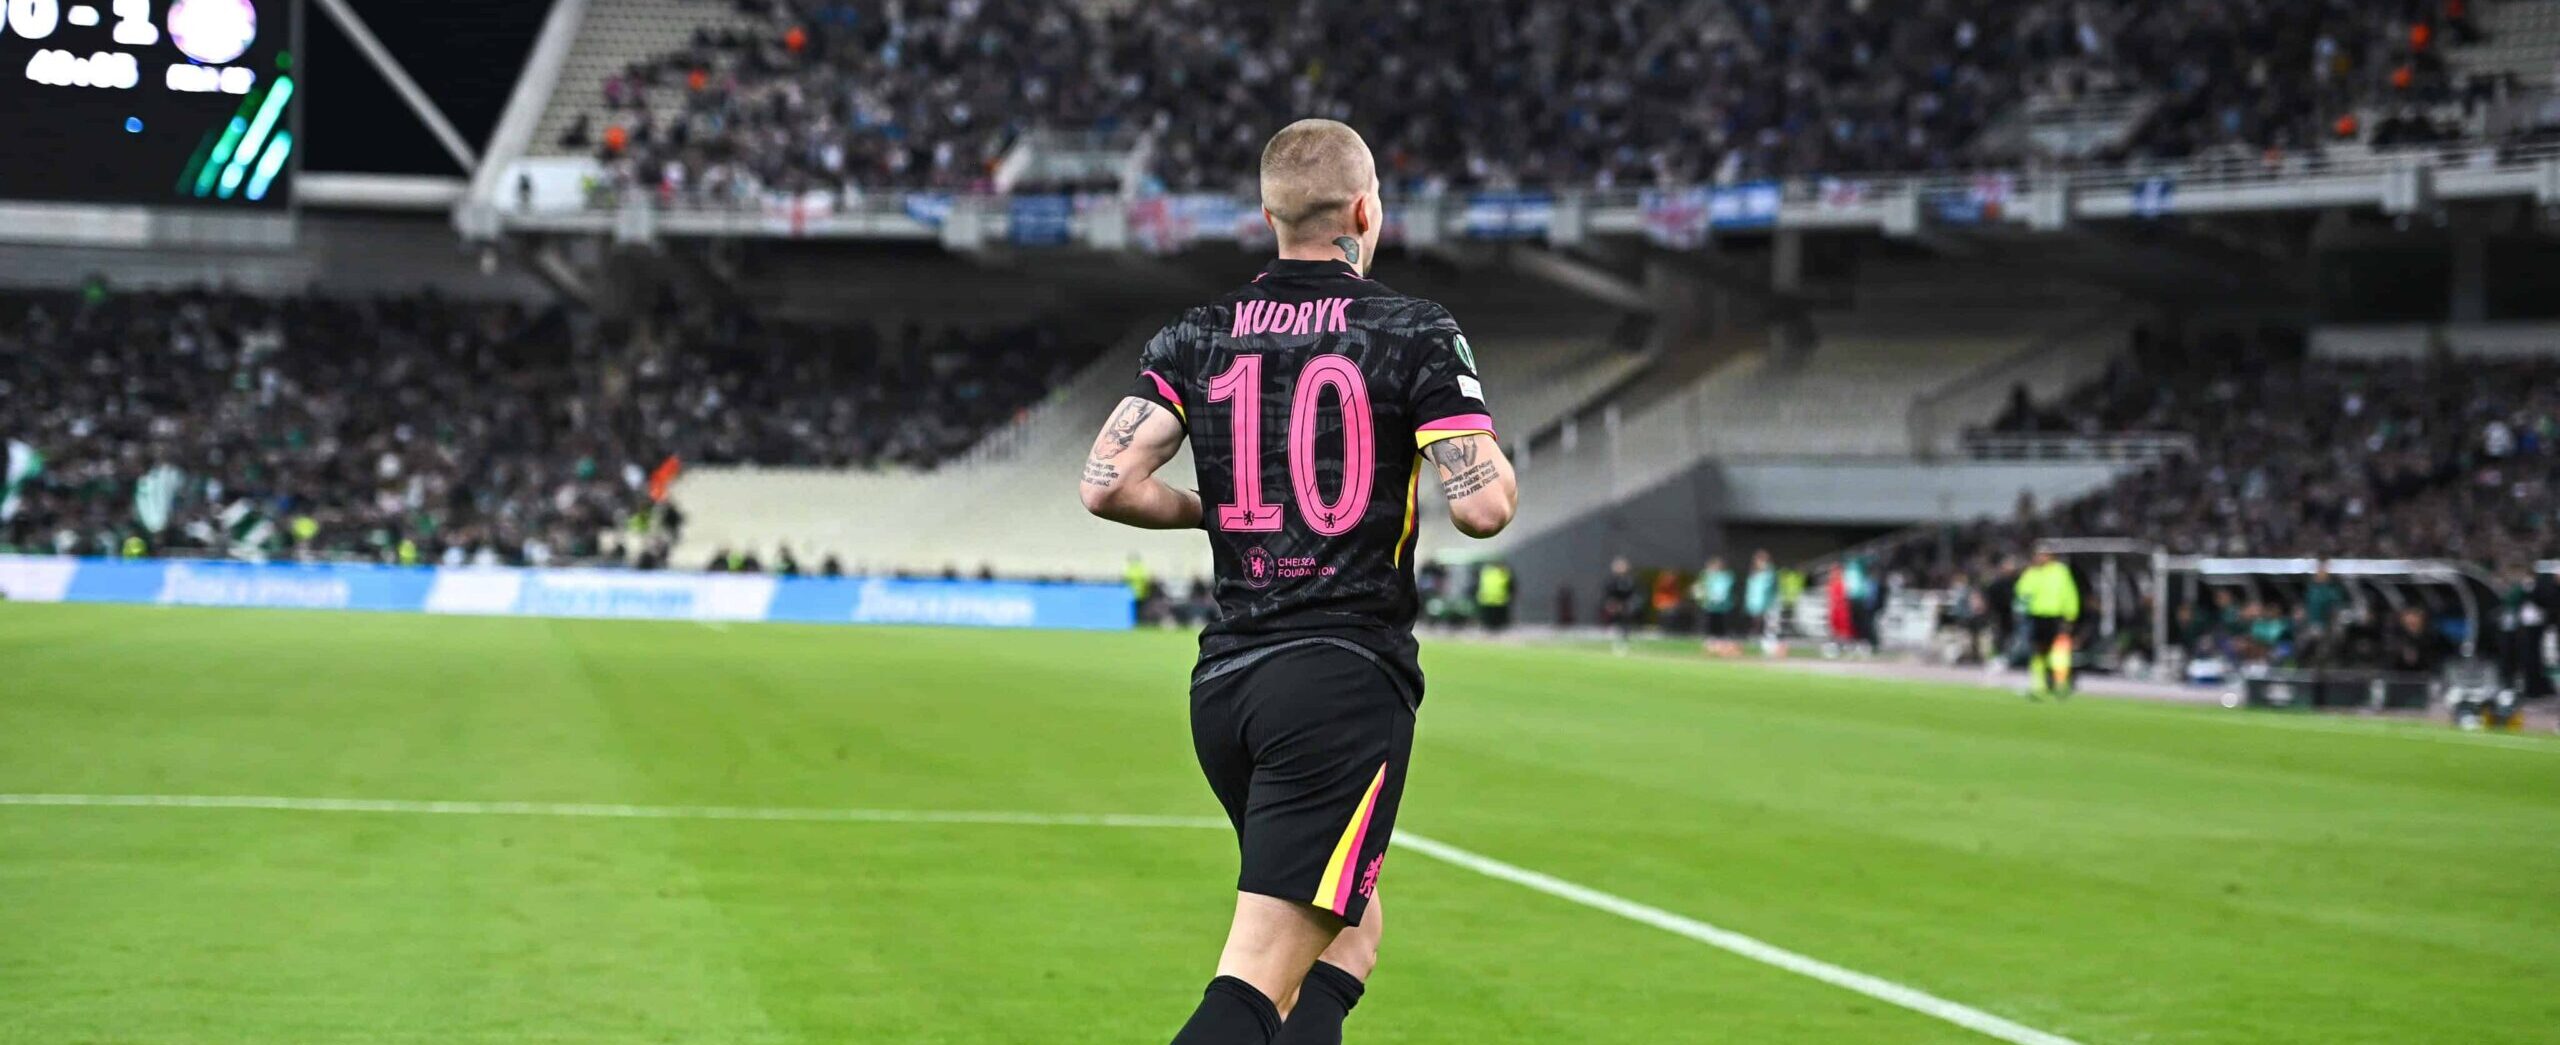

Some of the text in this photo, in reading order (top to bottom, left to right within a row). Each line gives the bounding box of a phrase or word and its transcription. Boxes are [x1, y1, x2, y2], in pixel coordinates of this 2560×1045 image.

[1231, 297, 1353, 338] MUDRYK
[1207, 353, 1376, 536] 10
[1277, 557, 1316, 566] CHELSEA
[1277, 567, 1336, 578] FOUDATION
